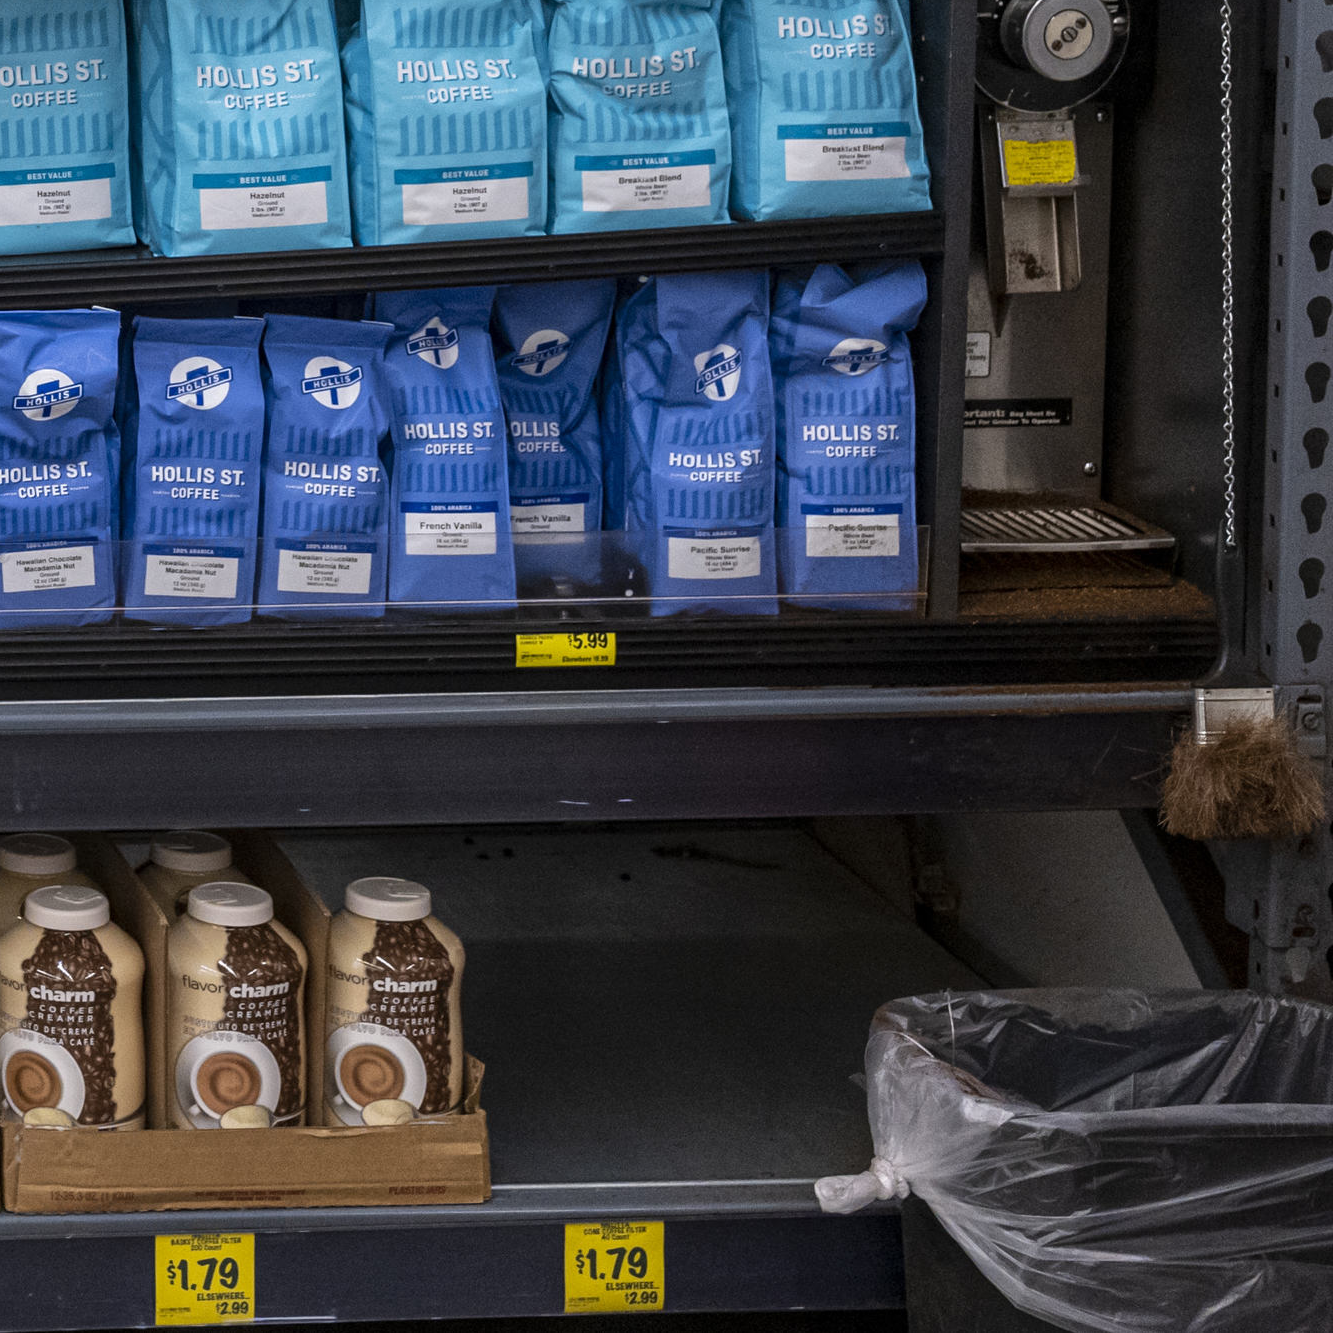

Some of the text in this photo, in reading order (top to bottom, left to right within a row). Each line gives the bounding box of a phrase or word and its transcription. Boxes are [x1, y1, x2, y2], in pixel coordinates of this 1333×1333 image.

[76, 58, 109, 83] ST.
[372, 977, 438, 993] charm
[167, 1257, 239, 1291] $1.79
[576, 1247, 647, 1280] $1.79
